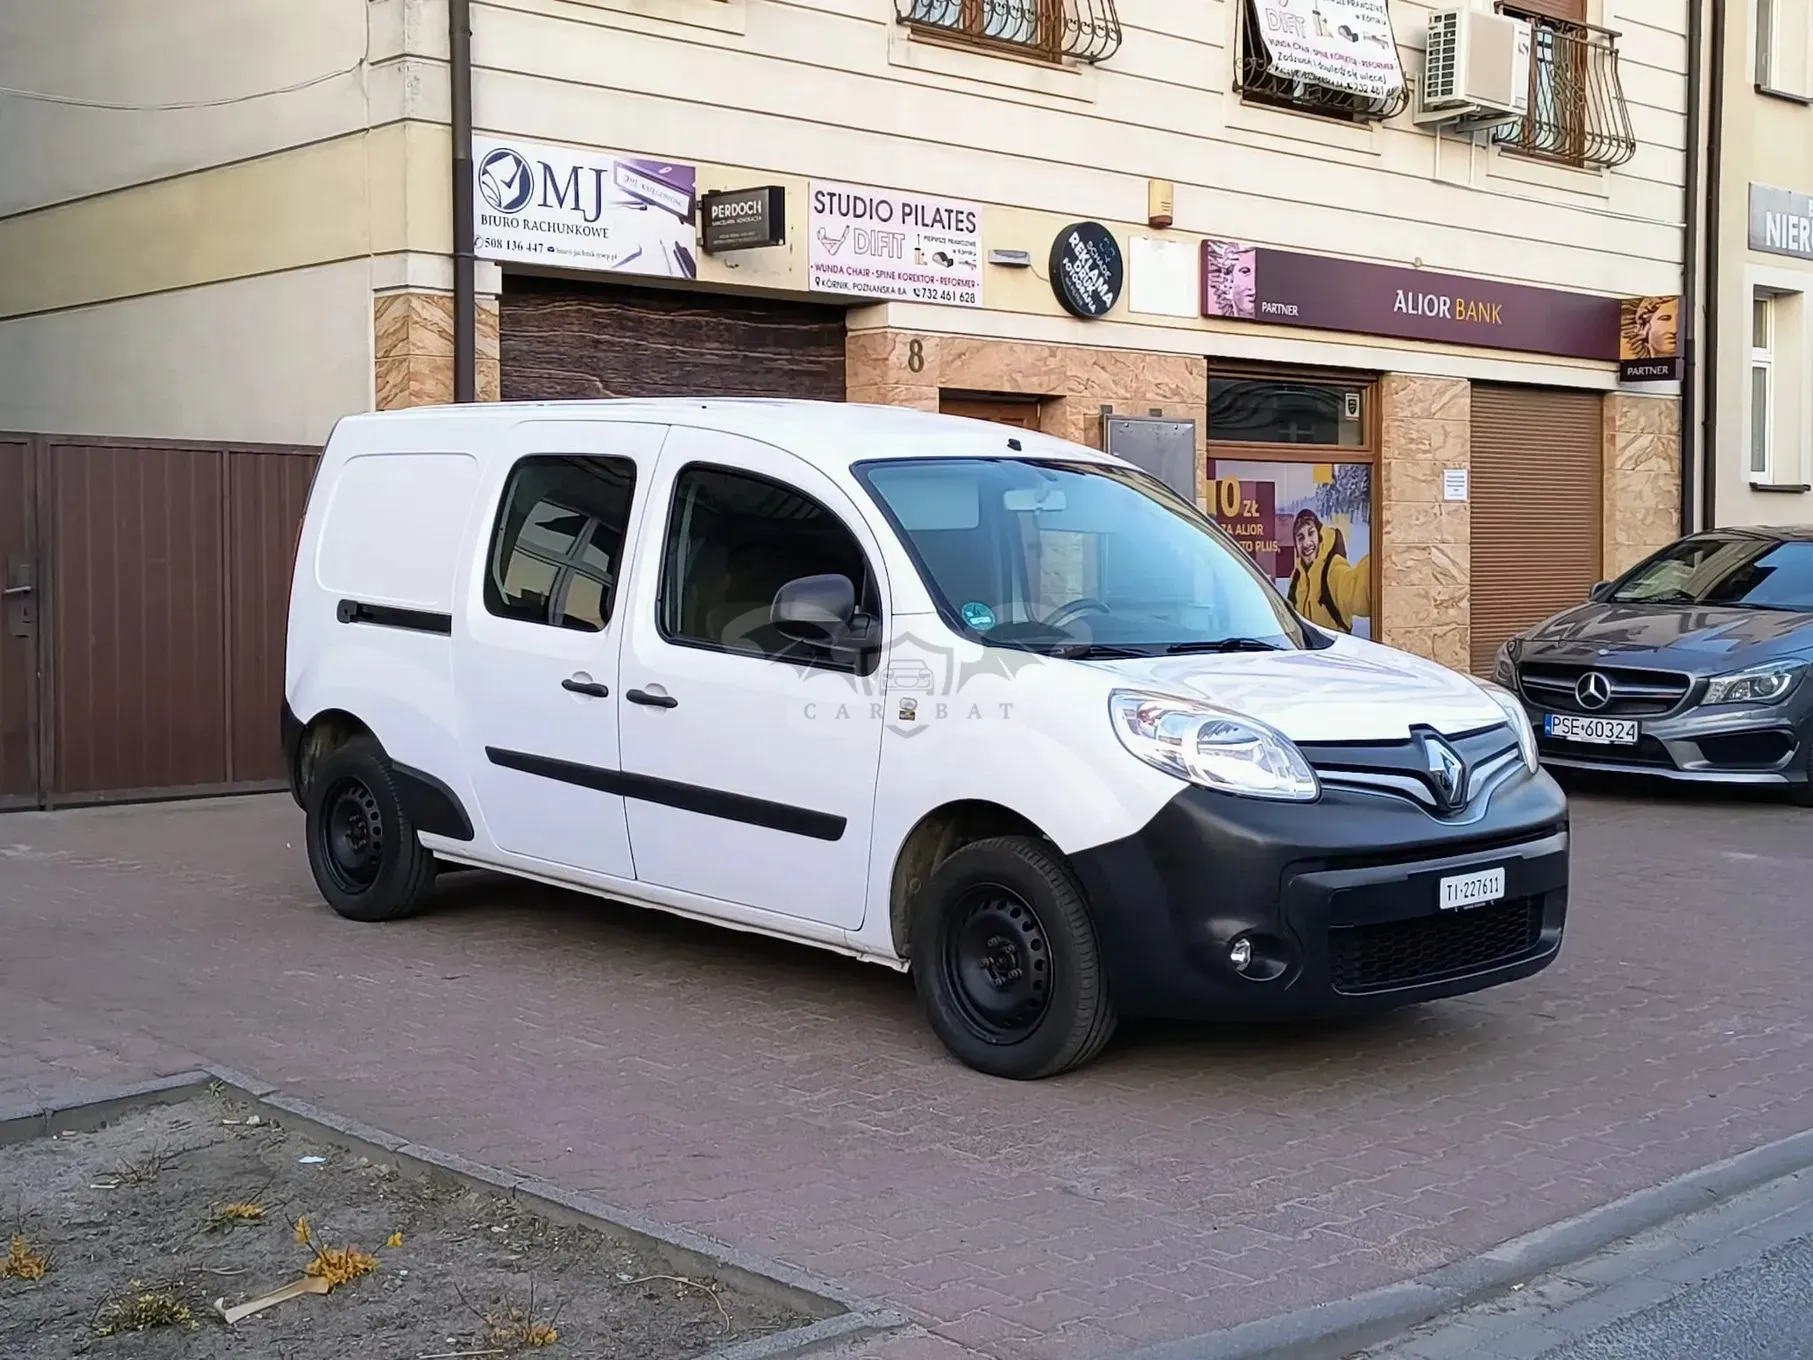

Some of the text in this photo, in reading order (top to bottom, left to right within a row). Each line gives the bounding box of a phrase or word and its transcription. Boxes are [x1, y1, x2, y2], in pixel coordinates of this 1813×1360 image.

[536, 160, 608, 223] MJ
[711, 199, 762, 219] PERDOCH
[814, 190, 977, 234] STUDIO PILATES
[481, 214, 609, 239] BIURO RACHUNKOWE
[1765, 211, 1813, 253] NIER
[484, 237, 503, 250] 508
[506, 240, 523, 252] 136
[526, 243, 544, 254] 447
[853, 227, 905, 260] DIFIT
[814, 263, 976, 288] WUNDA CHAIR SPINE KOREKTOR REFORMER
[1069, 231, 1113, 308] REKLAMA
[1074, 260, 1096, 296] DRUK
[922, 287, 938, 300] 732
[940, 290, 956, 302] 461
[960, 292, 976, 304] 628
[1062, 257, 1096, 313] FOTOGRAFIA
[1261, 301, 1299, 317] PARTNER
[1393, 289, 1503, 325] ALIOR BANK
[907, 338, 924, 373] 8
[1627, 363, 1669, 377] PARTNER
[1243, 500, 1260, 517] ZŁ
[1235, 523, 1264, 536] ALIOR
[1255, 541, 1281, 553] PLUS,
[1552, 716, 1636, 741] PSE 60324
